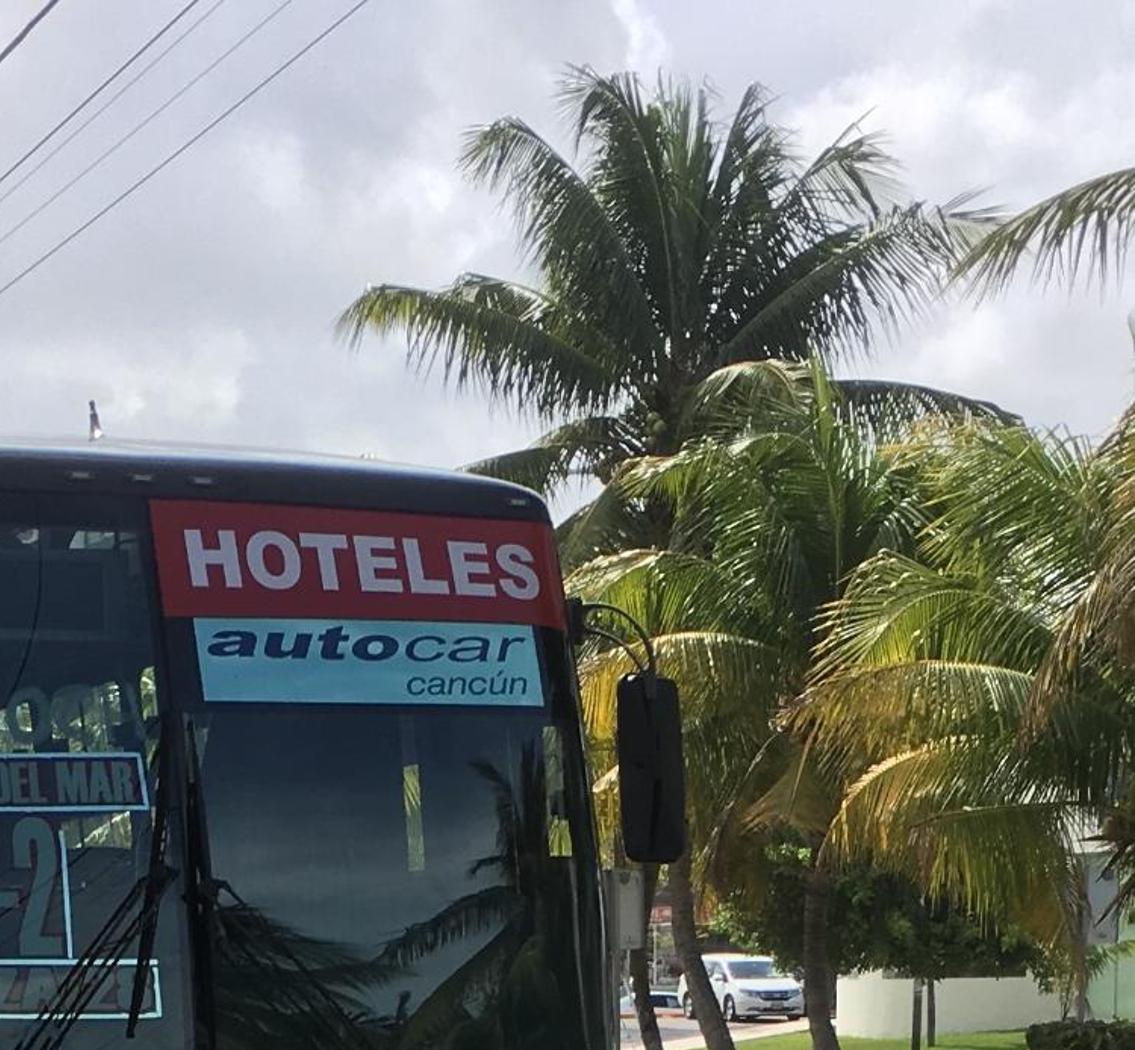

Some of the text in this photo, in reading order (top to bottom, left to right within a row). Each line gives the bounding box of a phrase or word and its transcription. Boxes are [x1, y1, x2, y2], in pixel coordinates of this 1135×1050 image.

[183, 528, 540, 600] HOTELES
[206, 625, 526, 663] autocar
[406, 670, 527, 697] cancún
[55, 762, 134, 804] MAR
